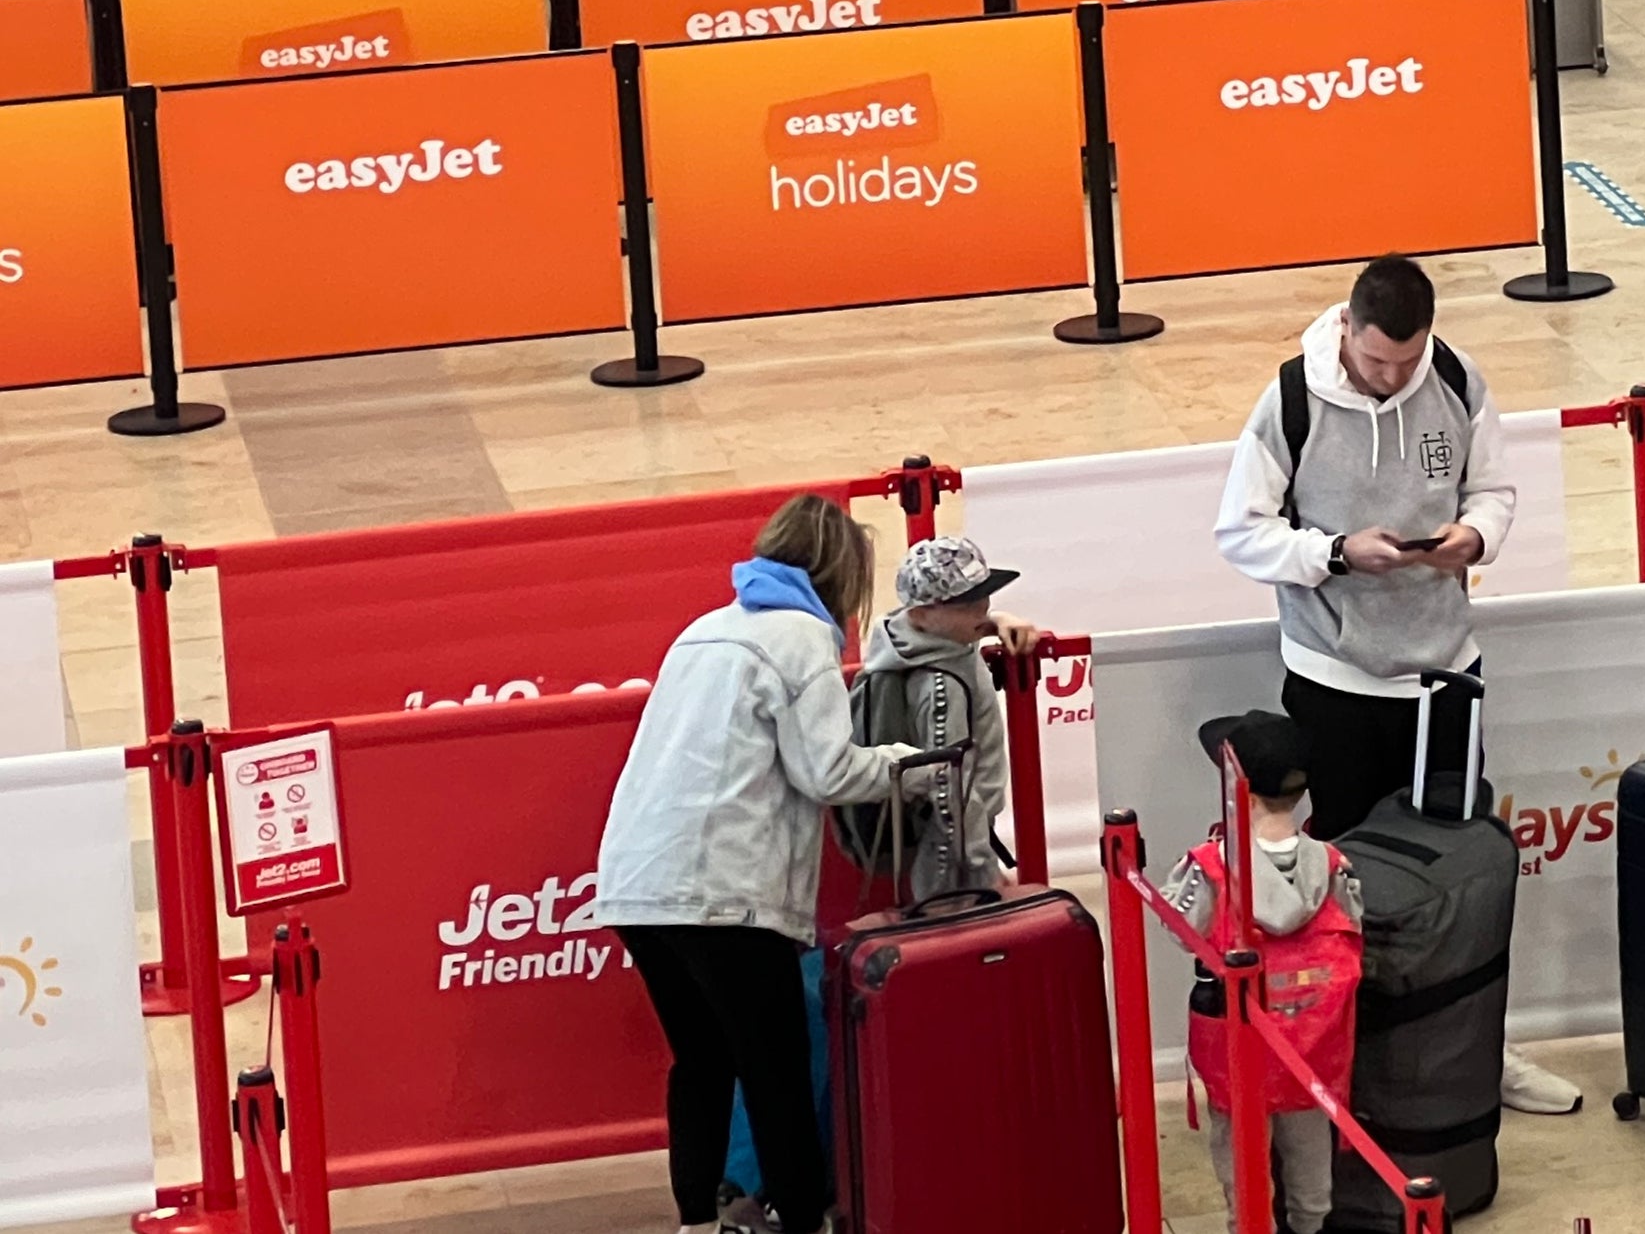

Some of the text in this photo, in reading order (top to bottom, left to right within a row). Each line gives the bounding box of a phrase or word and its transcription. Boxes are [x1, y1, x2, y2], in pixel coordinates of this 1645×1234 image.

[260, 35, 390, 69] easyJet
[1219, 56, 1424, 111] easyJet
[784, 102, 918, 138] easyJet
[284, 138, 504, 195] easyJet
[769, 154, 979, 212] holidays
[1046, 701, 1095, 726] Pac
[256, 856, 322, 881] Jet2.com
[437, 869, 604, 947] Jet2
[437, 938, 613, 991] Friendly
